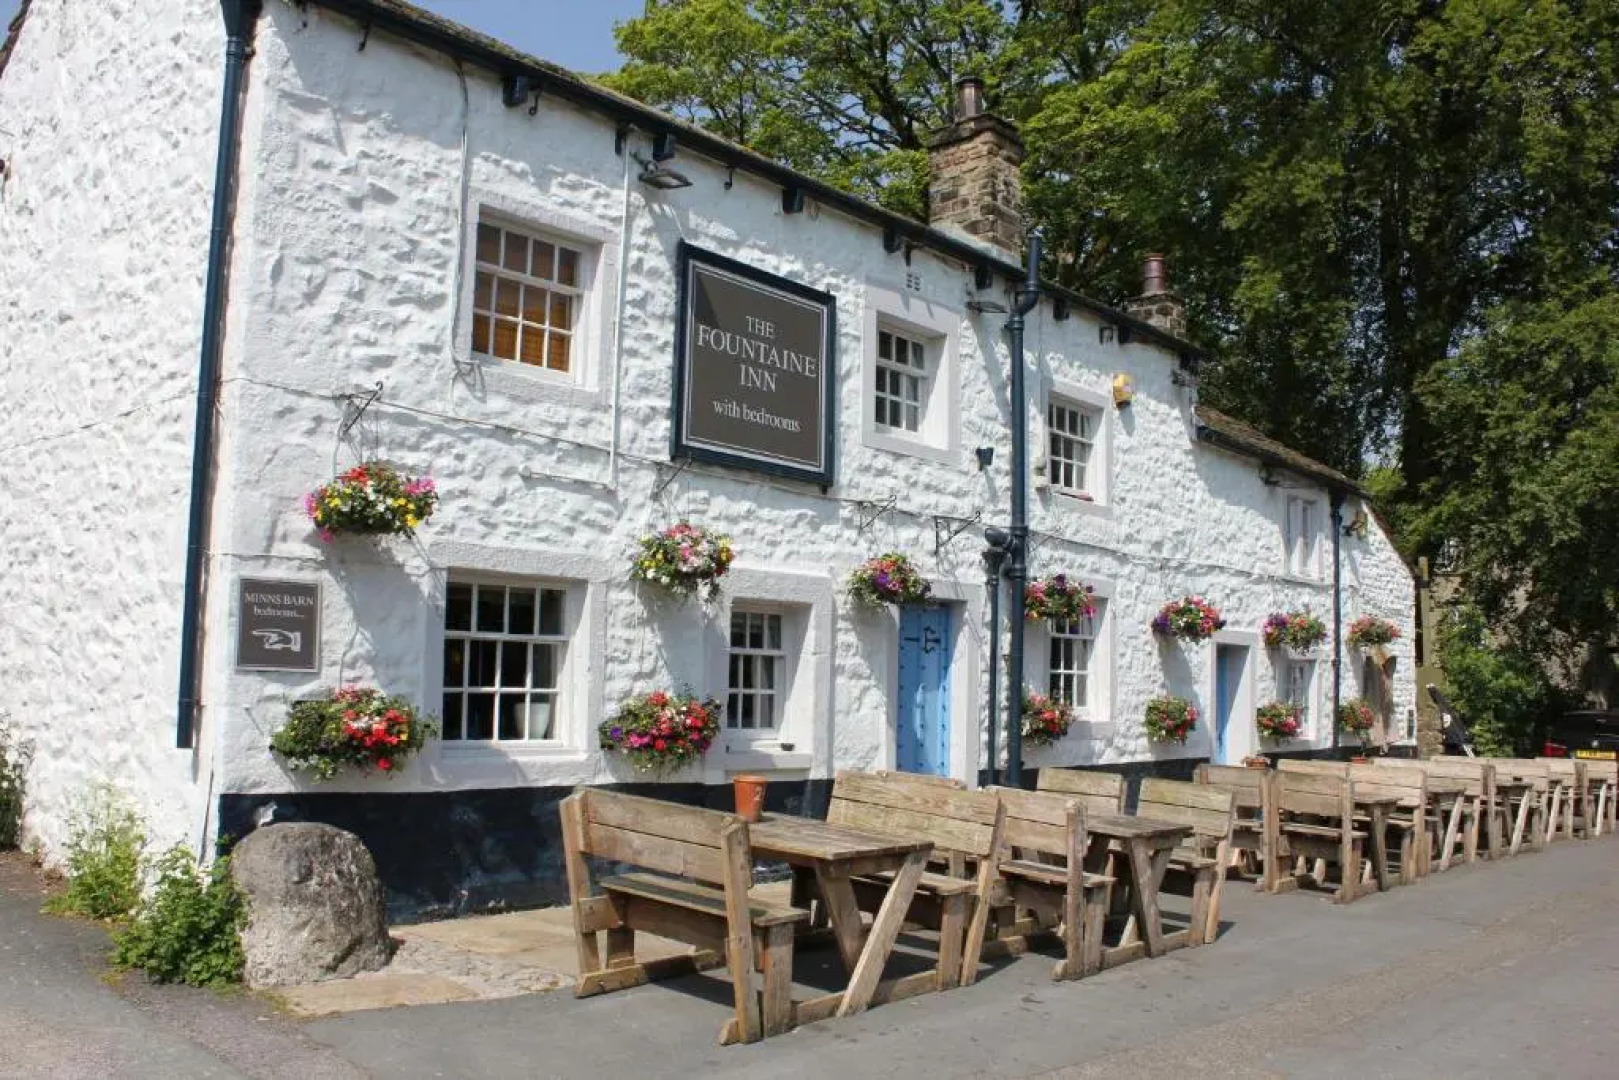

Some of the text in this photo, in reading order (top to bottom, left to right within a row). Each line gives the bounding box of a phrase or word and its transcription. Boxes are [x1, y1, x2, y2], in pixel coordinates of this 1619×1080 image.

[746, 316, 776, 338] THE
[697, 325, 817, 377] FOUNTAINE
[740, 365, 777, 392] INN
[713, 400, 800, 432] with bedrooms
[245, 593, 314, 605] MINNS BARN
